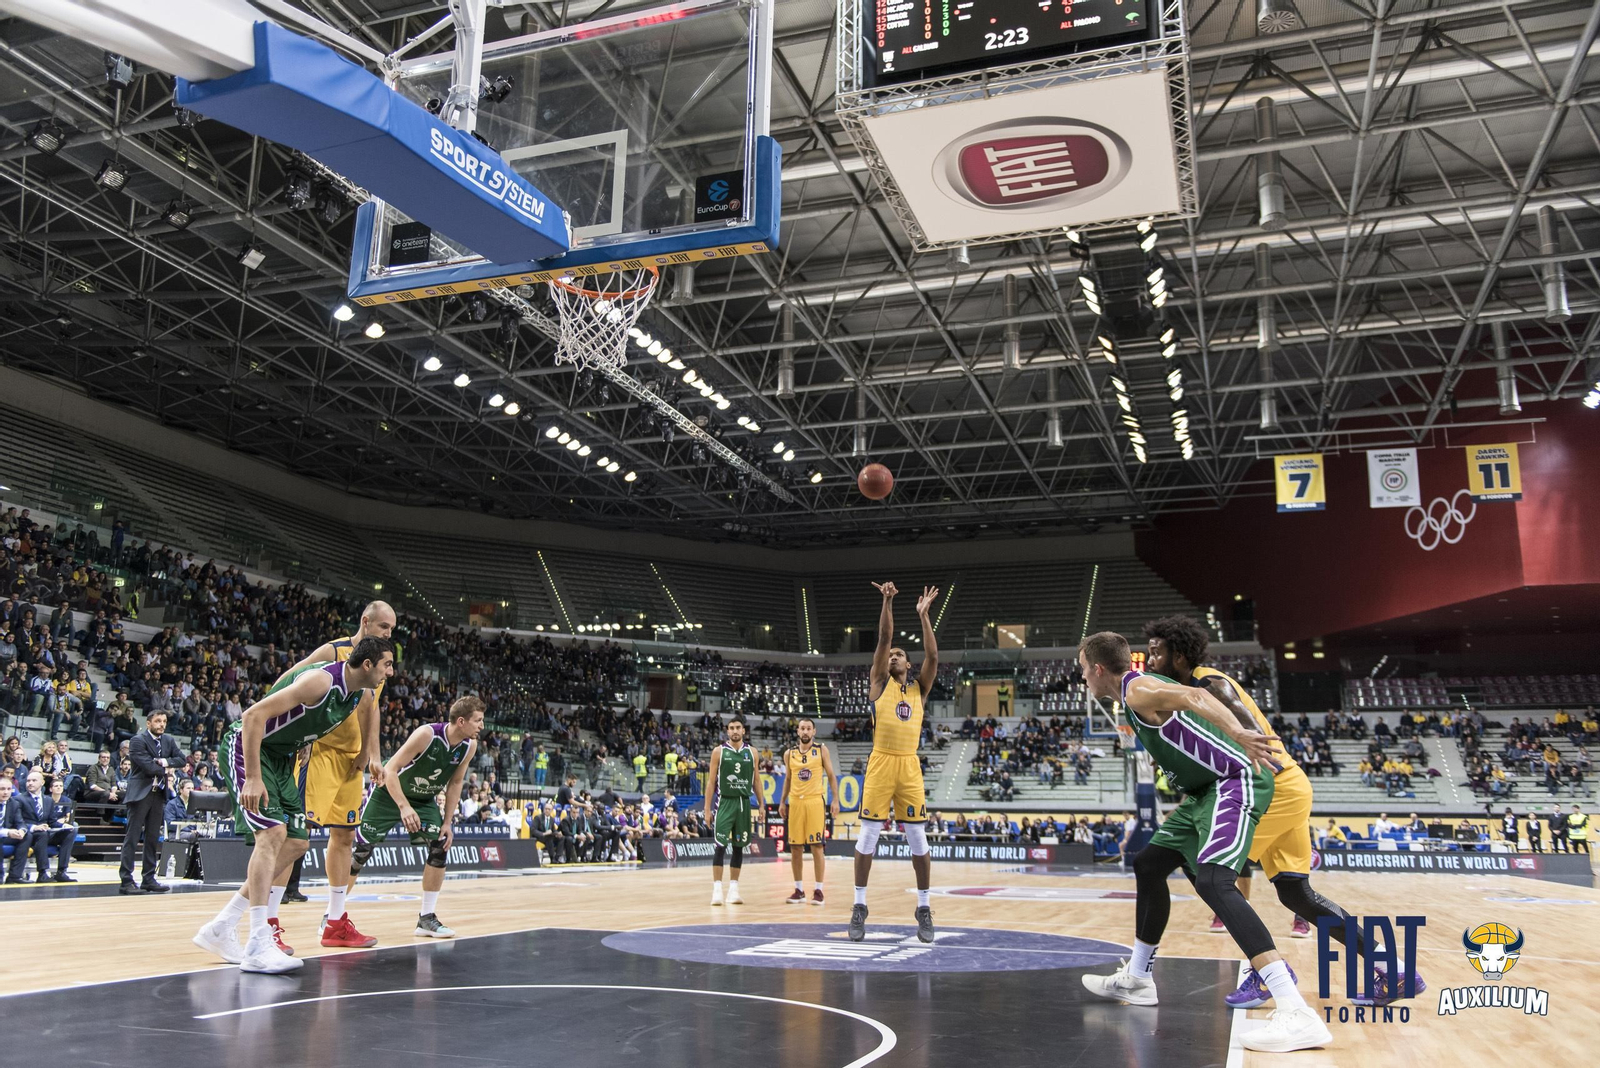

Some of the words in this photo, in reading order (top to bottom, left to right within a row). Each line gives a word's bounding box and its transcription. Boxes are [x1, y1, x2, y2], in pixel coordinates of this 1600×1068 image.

[876, 8, 887, 16] 14
[876, 24, 887, 32] 32
[984, 27, 1029, 50] 2:23
[431, 128, 491, 182] SPORT
[489, 170, 545, 218] SYSTEM
[983, 141, 1078, 197] FIAT
[697, 204, 728, 214] EuroCup
[396, 292, 416, 300] FIAT
[437, 285, 457, 294] FIAT
[490, 278, 510, 287] FIAT
[534, 272, 554, 281] FIAT
[578, 266, 598, 276] FIAT
[622, 260, 643, 270] FIAT
[670, 253, 690, 262] FIAT
[718, 246, 739, 256] FIAT
[1478, 462, 1511, 489] 11
[1288, 472, 1311, 498] 7
[802, 754, 808, 764] 8
[734, 762, 741, 774] 3
[920, 804, 926, 818] 4
[742, 832, 748, 842] 3
[769, 826, 784, 837] 20
[816, 832, 821, 842] 8
[776, 840, 784, 852] 3
[954, 846, 966, 858] IN
[968, 846, 987, 858] THE
[990, 847, 1026, 860] WORLD
[402, 847, 414, 866] IN
[1346, 854, 1416, 868] CROISSANT
[1419, 855, 1434, 868] IN
[1436, 856, 1460, 869] THE
[1463, 856, 1508, 870] WORLD
